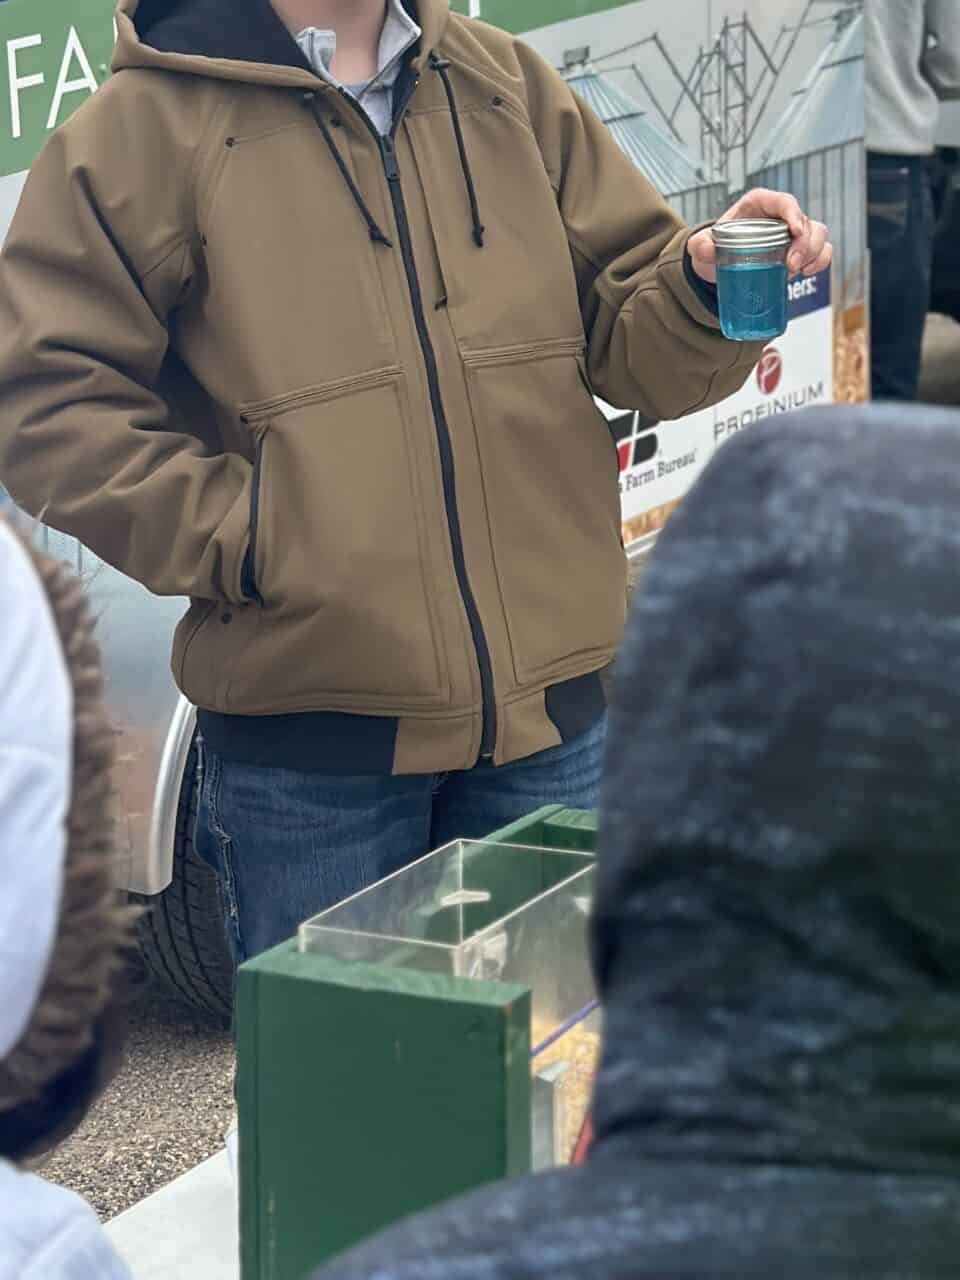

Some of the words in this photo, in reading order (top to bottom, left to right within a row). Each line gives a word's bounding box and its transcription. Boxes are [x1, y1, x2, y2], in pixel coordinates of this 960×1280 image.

[6, 15, 119, 139] FA
[713, 380, 824, 441] PROFINIUM
[624, 468, 655, 492] Farm
